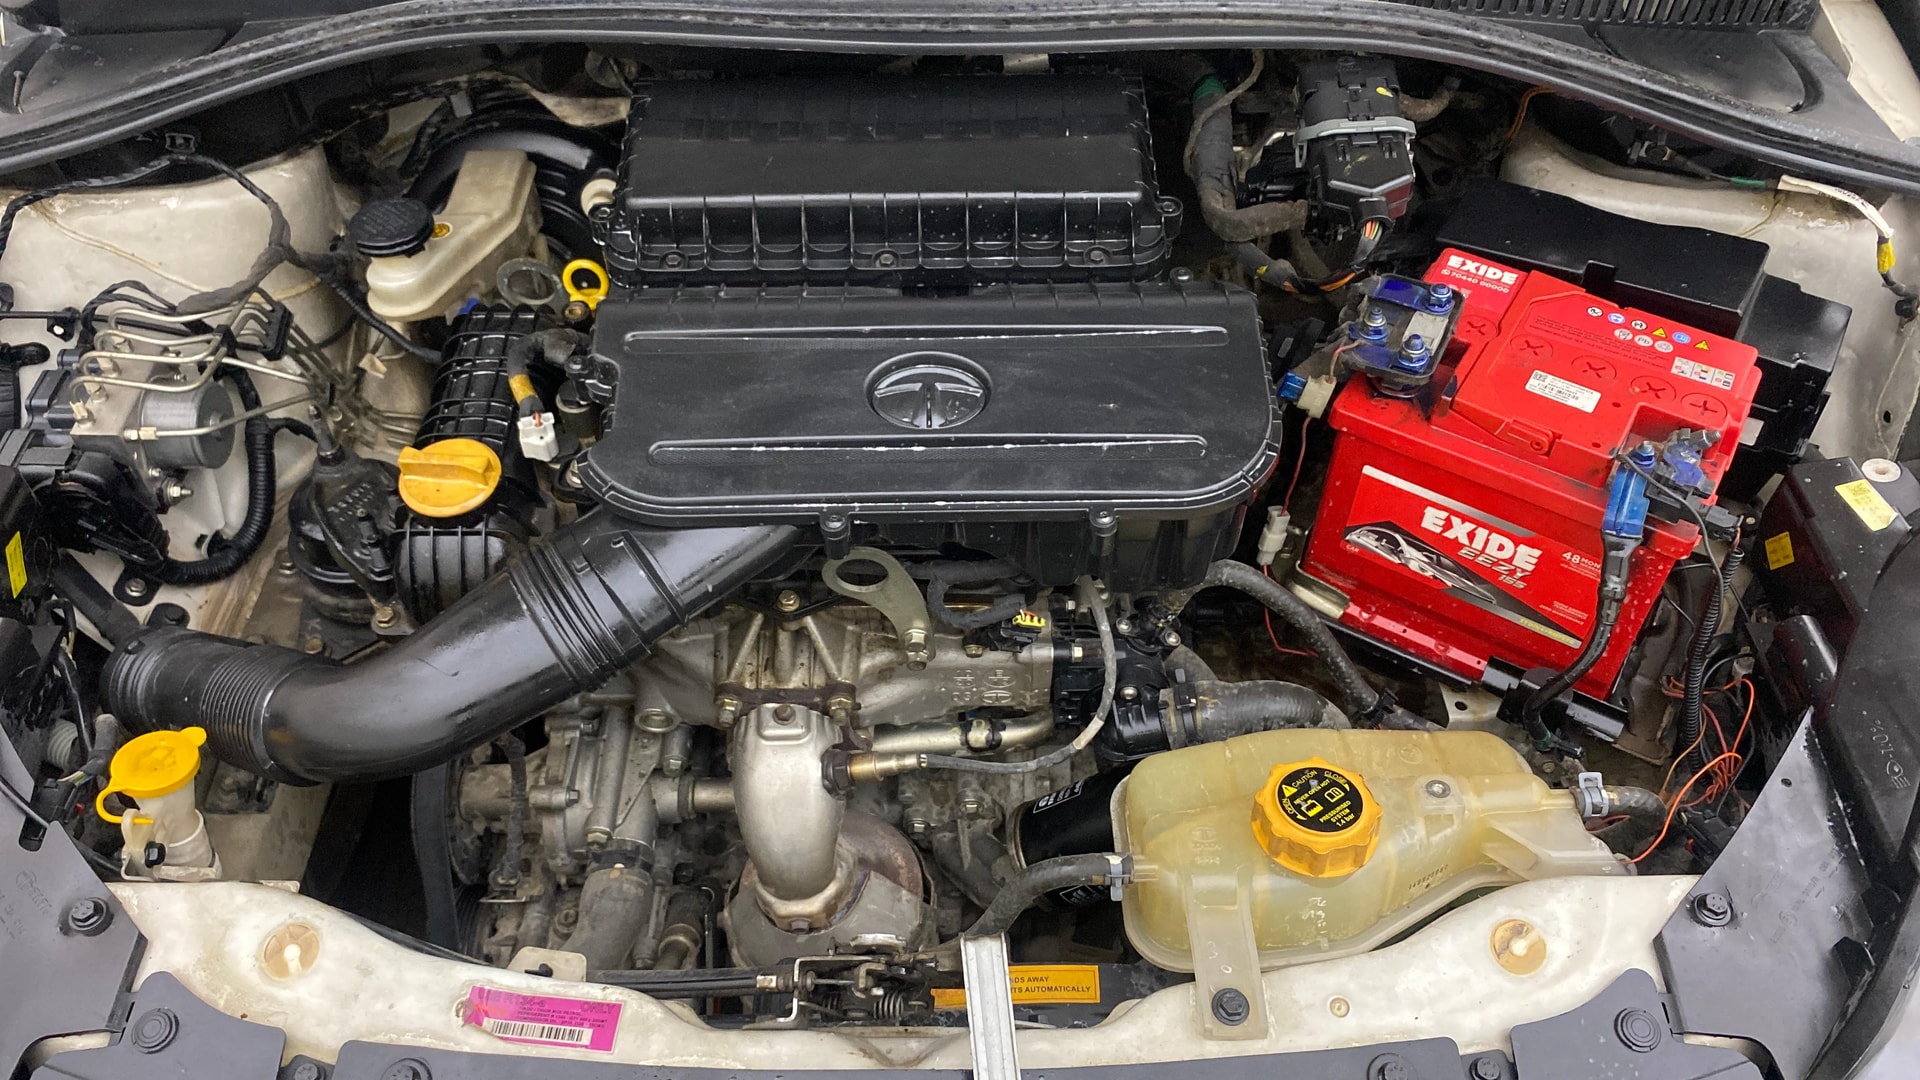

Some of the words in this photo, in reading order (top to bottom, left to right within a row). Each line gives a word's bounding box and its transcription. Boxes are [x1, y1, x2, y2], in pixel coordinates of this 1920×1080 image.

[1447, 254, 1519, 285] EXIDE
[1450, 271, 1479, 284] 70440
[1479, 280, 1509, 293] 00000
[1420, 505, 1543, 572] EXIDE
[1457, 547, 1531, 579] EEZY
[1561, 551, 1581, 564] 48
[1498, 574, 1527, 590] 155
[1291, 769, 1318, 788] CAUTION
[1323, 770, 1348, 785] CLOSE
[1293, 793, 1309, 805] NEVER
[1308, 785, 1321, 796] OPEN
[1330, 808, 1351, 823] SYSTEM
[1344, 813, 1355, 822] bar
